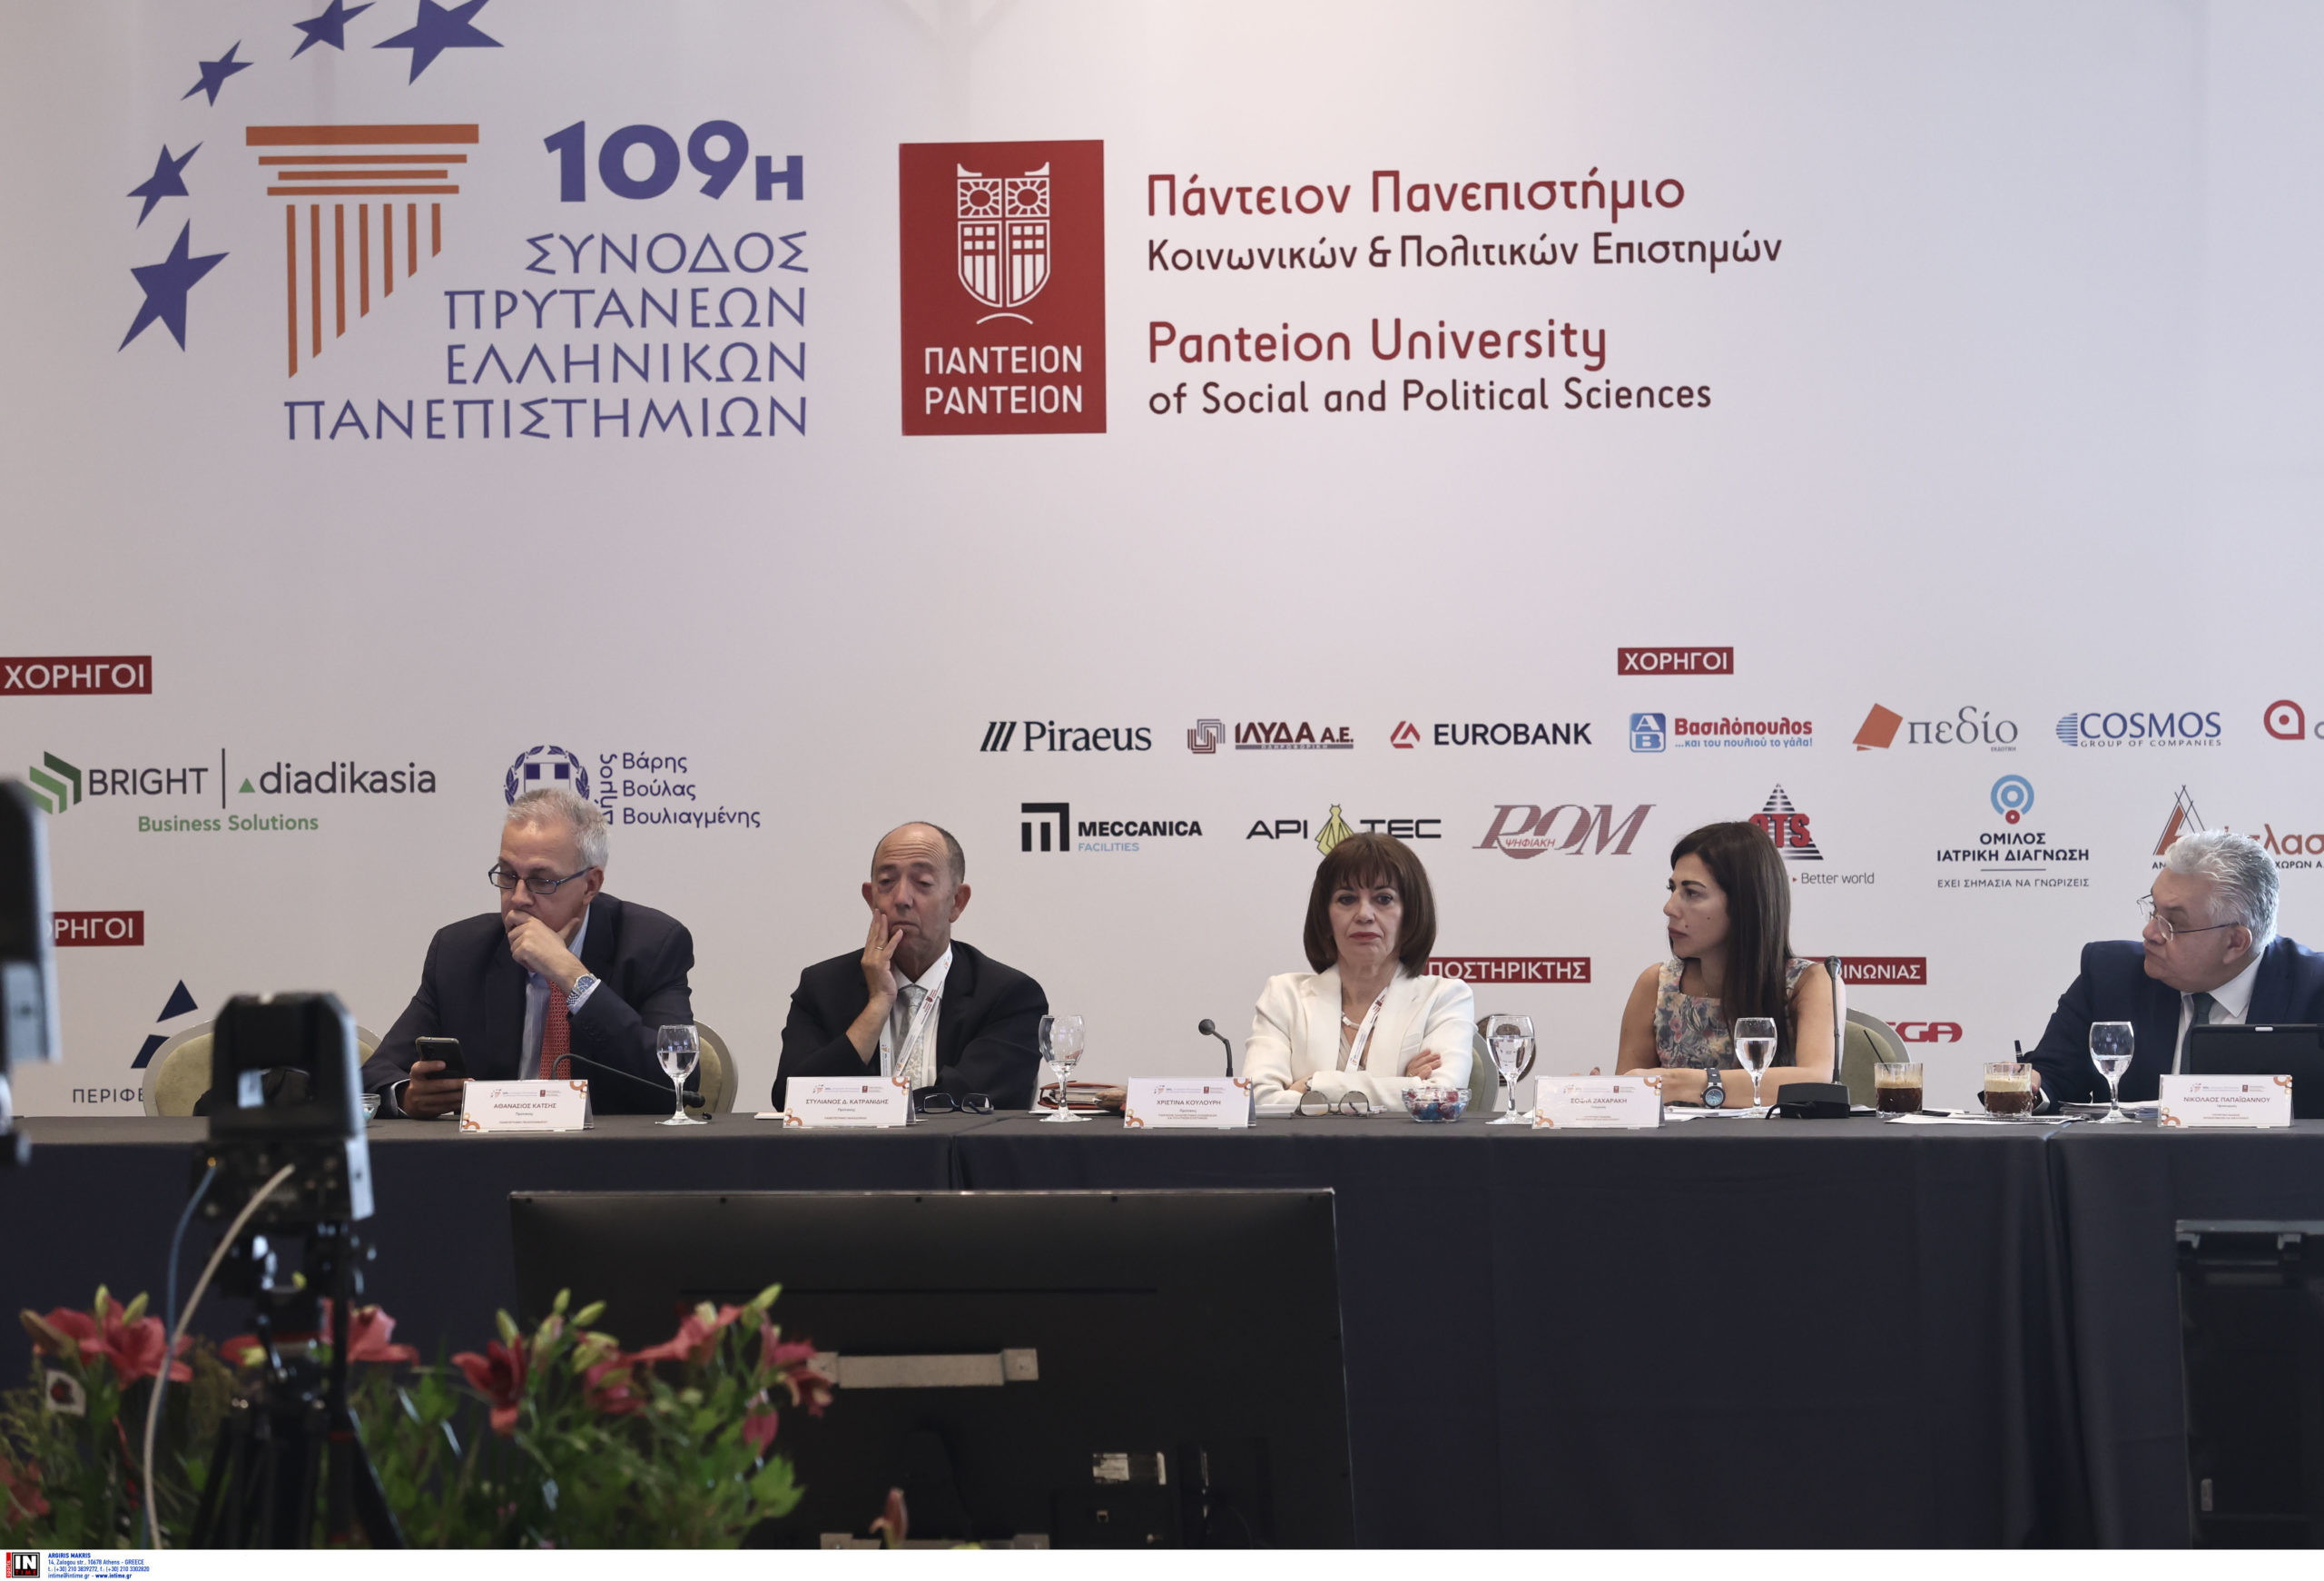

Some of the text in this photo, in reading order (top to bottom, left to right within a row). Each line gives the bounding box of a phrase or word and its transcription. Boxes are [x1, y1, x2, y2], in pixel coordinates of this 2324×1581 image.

[1148, 166, 1685, 224] Πάντειον Πανεπιστήμιο
[525, 231, 809, 275] ΣΥΝΟΔΟΣ
[1149, 230, 1783, 274] Κοινωνικών & Πολιτικών Επιστημών
[444, 287, 805, 331] ΠΡΥΤΑΝΕΩΝ
[1148, 318, 1606, 372] Panteion University
[447, 341, 806, 385] ΕΛΛΗΝΙΚΩΝ
[924, 344, 1082, 375] ΠΑΝΤΕΙΟΝ
[1149, 376, 1711, 415] of Social and Political Sciences
[284, 396, 806, 441] ΠΑΝΕΠΙΣΤΗΜΙΩΝ
[1624, 651, 1728, 672] ΧΟΡΗΓΟΙ
[4, 663, 145, 690] ΧΟΡΗΓΟΙ
[1023, 720, 1152, 752] Piraeus
[1235, 722, 1354, 744] ΙΛΥΔΑ Α.Ε.
[1433, 723, 1592, 746] EUROBANK
[1674, 716, 1813, 736] Βασιλόπουλος
[1907, 706, 2018, 745] πεδίο
[2080, 711, 2222, 739] COSMOS
[1704, 739, 1721, 747] του
[1724, 736, 1768, 747] πουλιού
[1770, 738, 1781, 747] το
[1784, 737, 1813, 748] γάλα!
[2081, 738, 2222, 748] GROUP OF COMPANIES
[622, 751, 688, 774] Βάρης
[88, 760, 437, 796] BRIGHT diadikasia
[622, 780, 696, 801] Βούλας
[138, 813, 320, 833] Business Solutions
[622, 806, 762, 828] Βουλιαγμένης
[1078, 820, 1203, 837] MECCANICA
[1980, 833, 2046, 845] ΟΜΙΛΟΣ
[1078, 842, 1140, 853] FACILITIES
[1505, 838, 1556, 847] ΨΗΦΙΑΚΗ
[1937, 849, 2090, 862] ΙΑΤΡΙΚΗ ΔΙΑΓΝΩΣΗ
[1801, 872, 1876, 884] Better world
[1937, 878, 2090, 888] ΕΧΕΙ ΣΗΜΑΣΙΑ ΝΑ ΓΝΩΡΙΖΕΙΣ
[1425, 961, 1587, 980] ΠΟΣΤΗΡΙΚΤΗΣ
[1841, 963, 1922, 980] ΙΝΩΝΙΑΣ
[1886, 1022, 1964, 1043] GA
